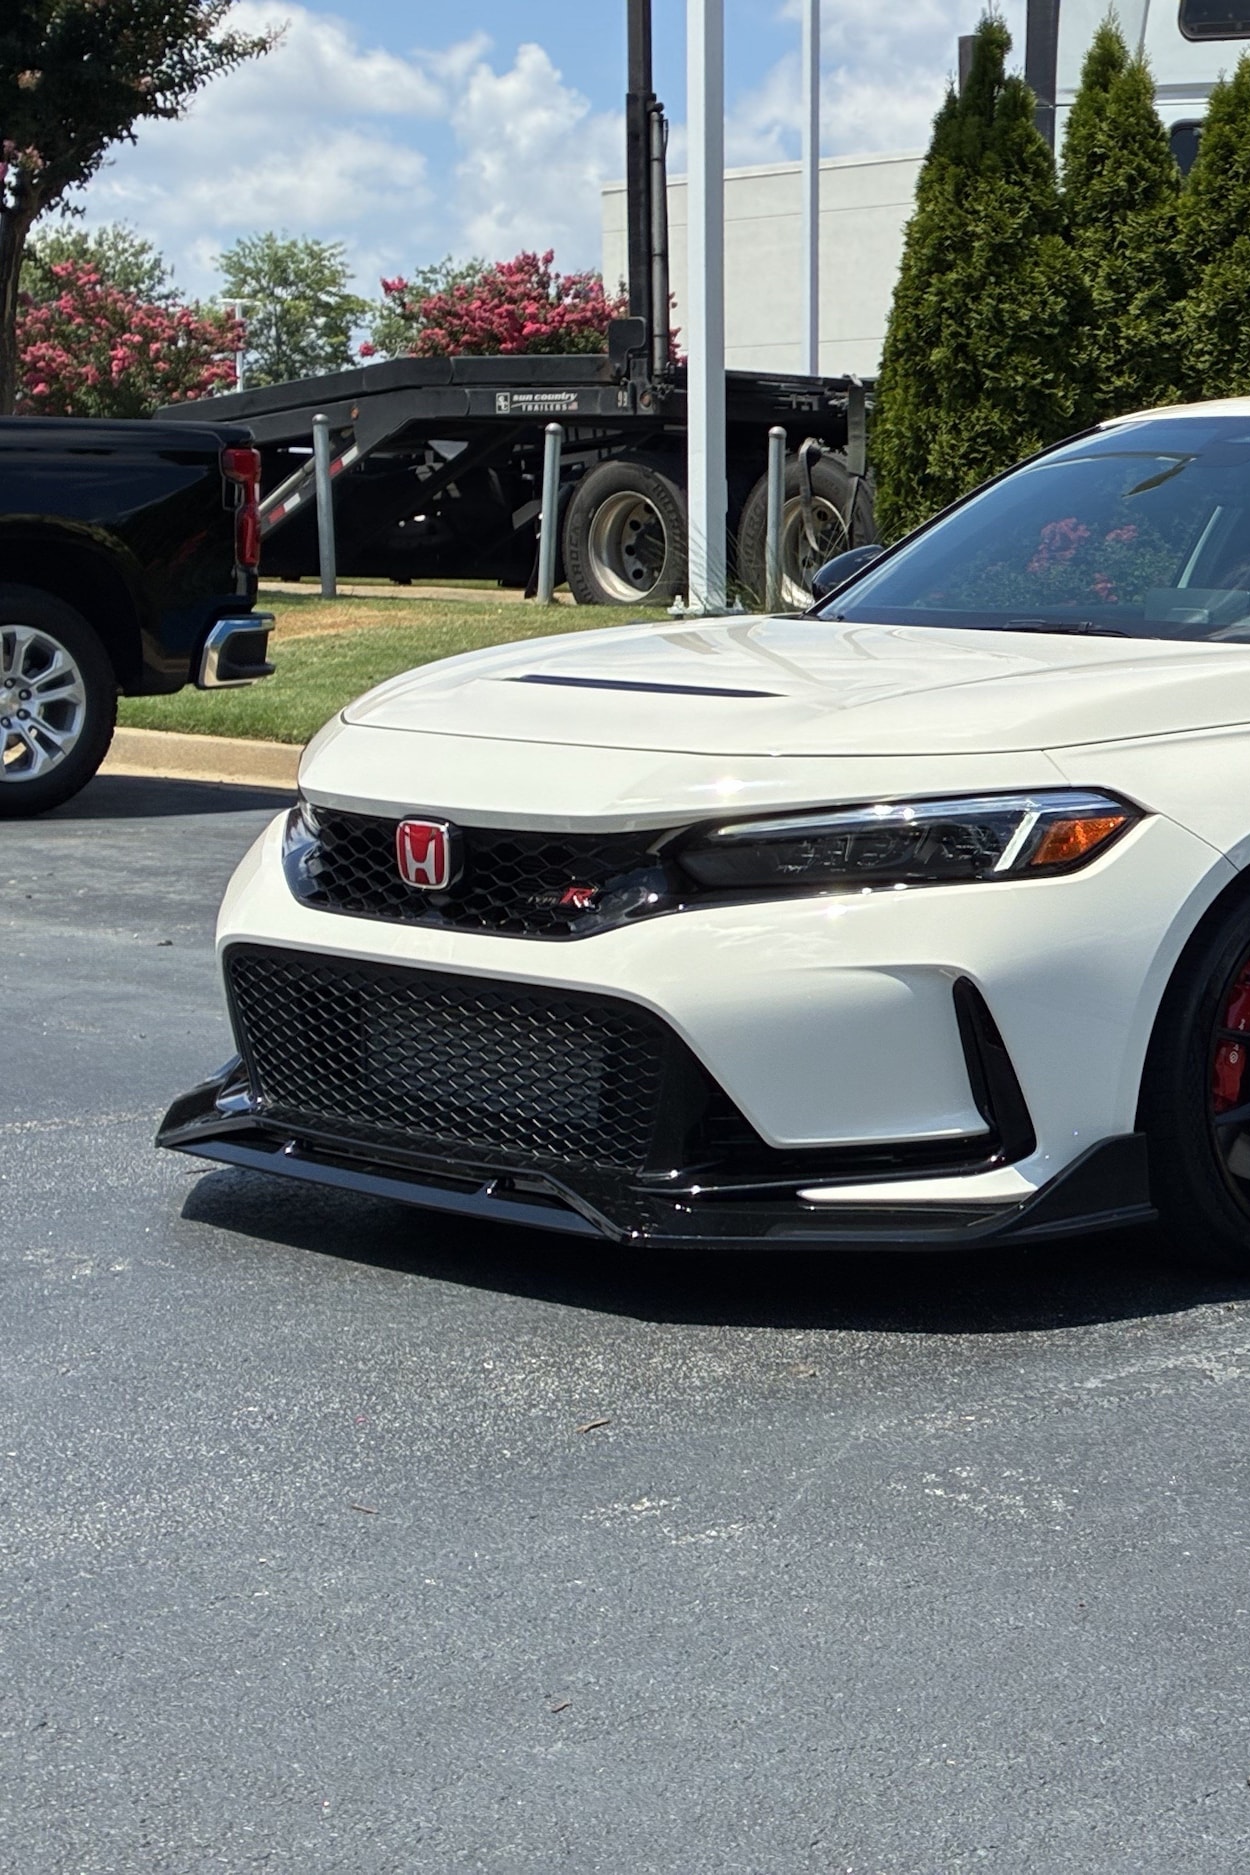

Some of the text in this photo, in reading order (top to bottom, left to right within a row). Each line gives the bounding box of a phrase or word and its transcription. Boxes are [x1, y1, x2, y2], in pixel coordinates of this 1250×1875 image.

[534, 392, 578, 401] country
[521, 403, 567, 412] TRAILERS
[559, 886, 597, 908] R
